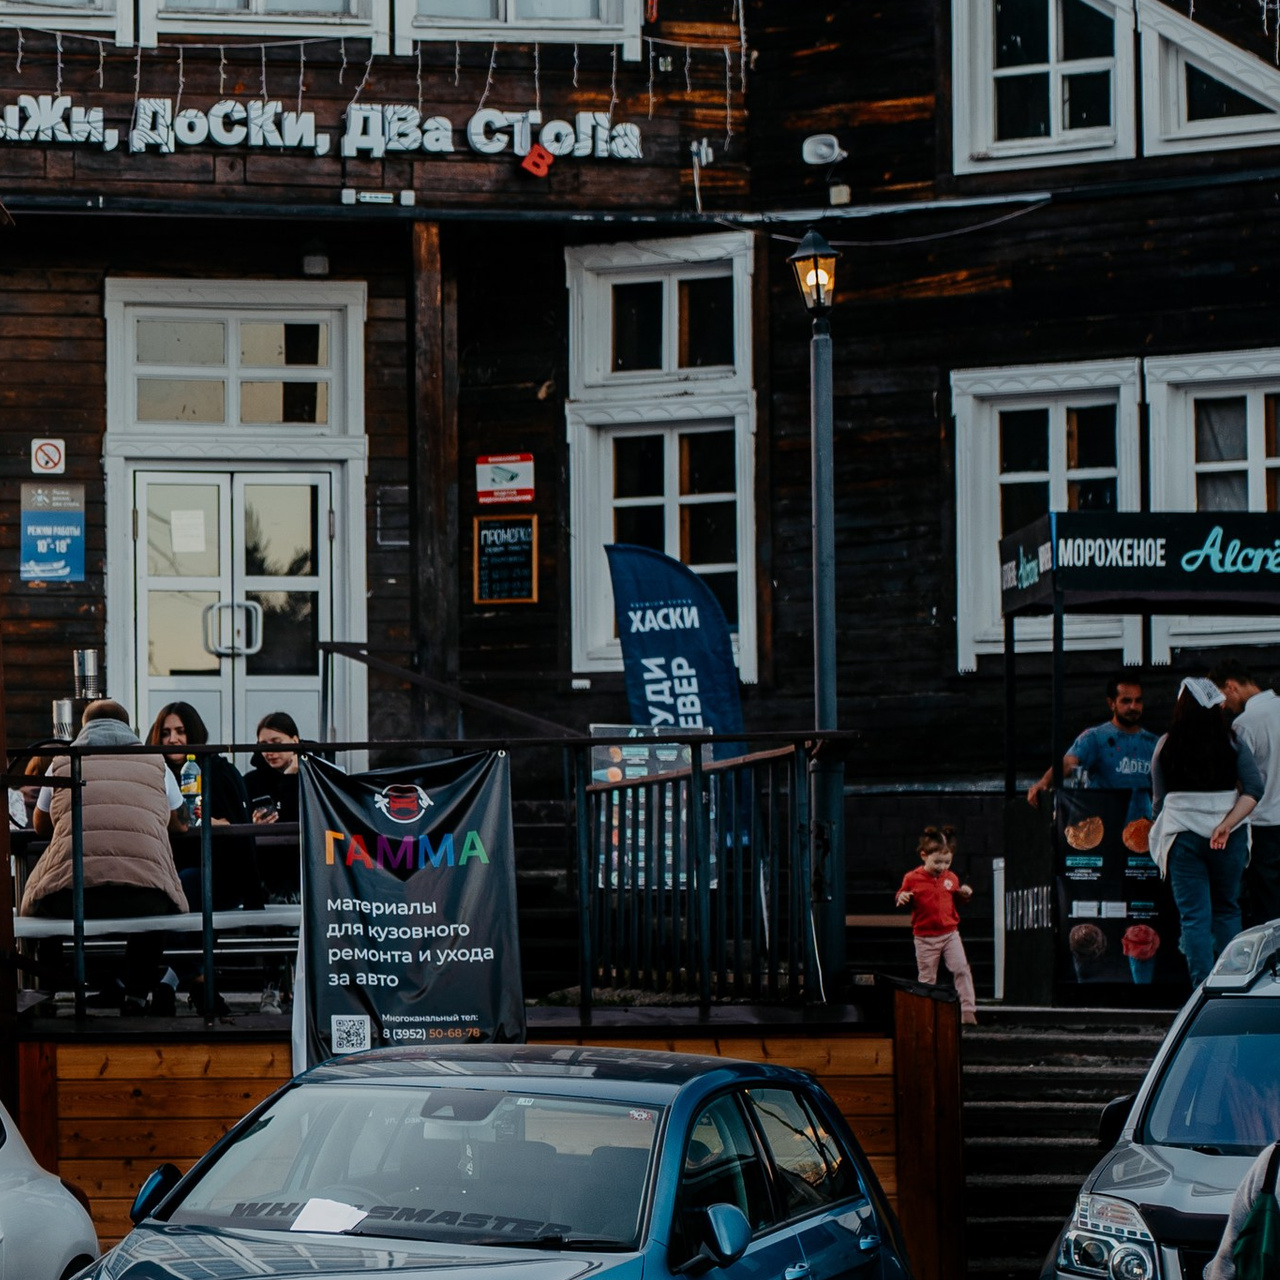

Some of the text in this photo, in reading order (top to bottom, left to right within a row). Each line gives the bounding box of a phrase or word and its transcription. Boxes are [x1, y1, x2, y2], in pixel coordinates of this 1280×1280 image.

[26, 526, 80, 537] РЕЖИМ РАБОТЫ
[1058, 537, 1167, 568] МОРОЖЕНОЕ
[627, 605, 700, 634] ХАСКИ
[324, 829, 490, 870] ГАММА
[326, 898, 437, 918] материалы
[326, 922, 470, 942] для кузовного
[328, 947, 494, 965] ремонта и ухода
[328, 972, 400, 988] за авто
[381, 1013, 478, 1023] Многоканальный тел:
[382, 1028, 480, 1040] 8 (3952) 50-68-78
[231, 1202, 572, 1236] WHSMASTER
